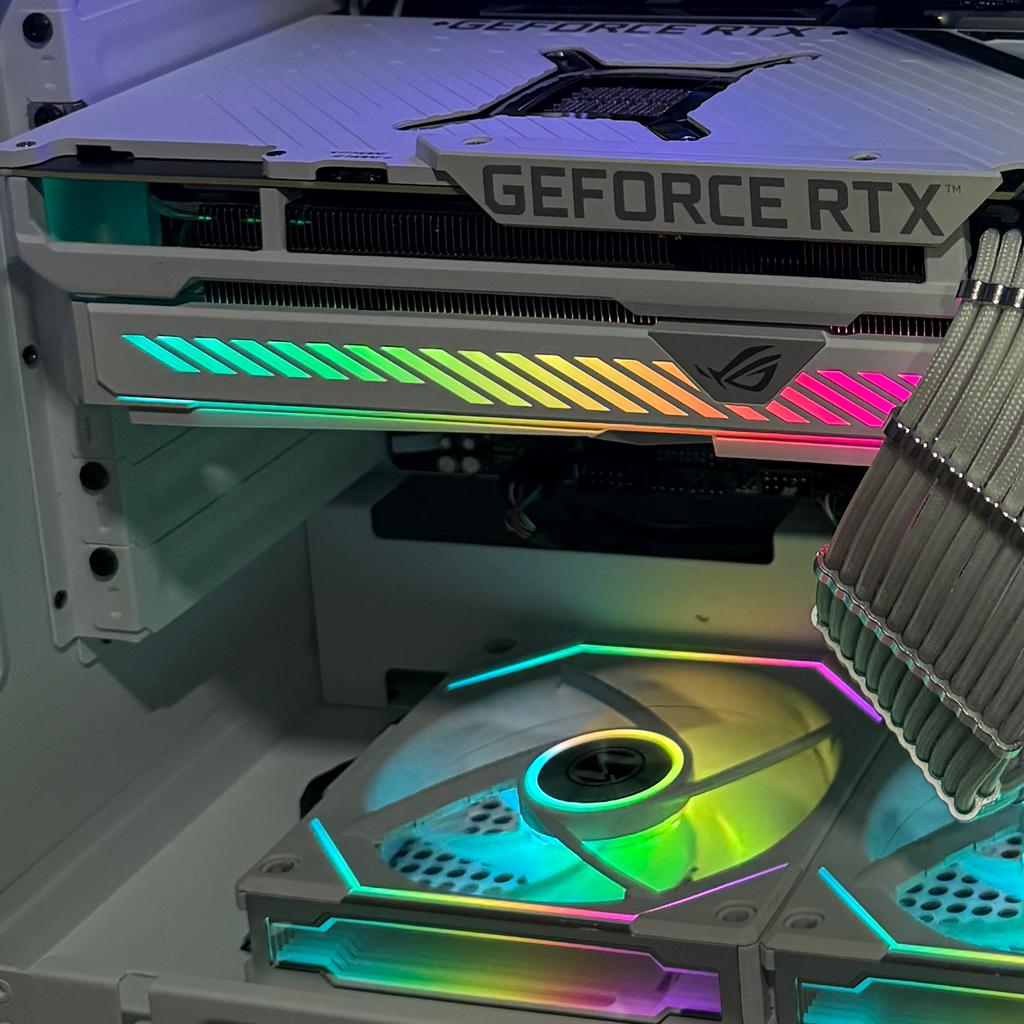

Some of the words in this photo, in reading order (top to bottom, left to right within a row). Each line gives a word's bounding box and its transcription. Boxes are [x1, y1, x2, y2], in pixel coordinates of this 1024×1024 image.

[448, 19, 697, 35] GEFORCE
[701, 24, 816, 38] RTX
[483, 164, 788, 229] GEFORCE
